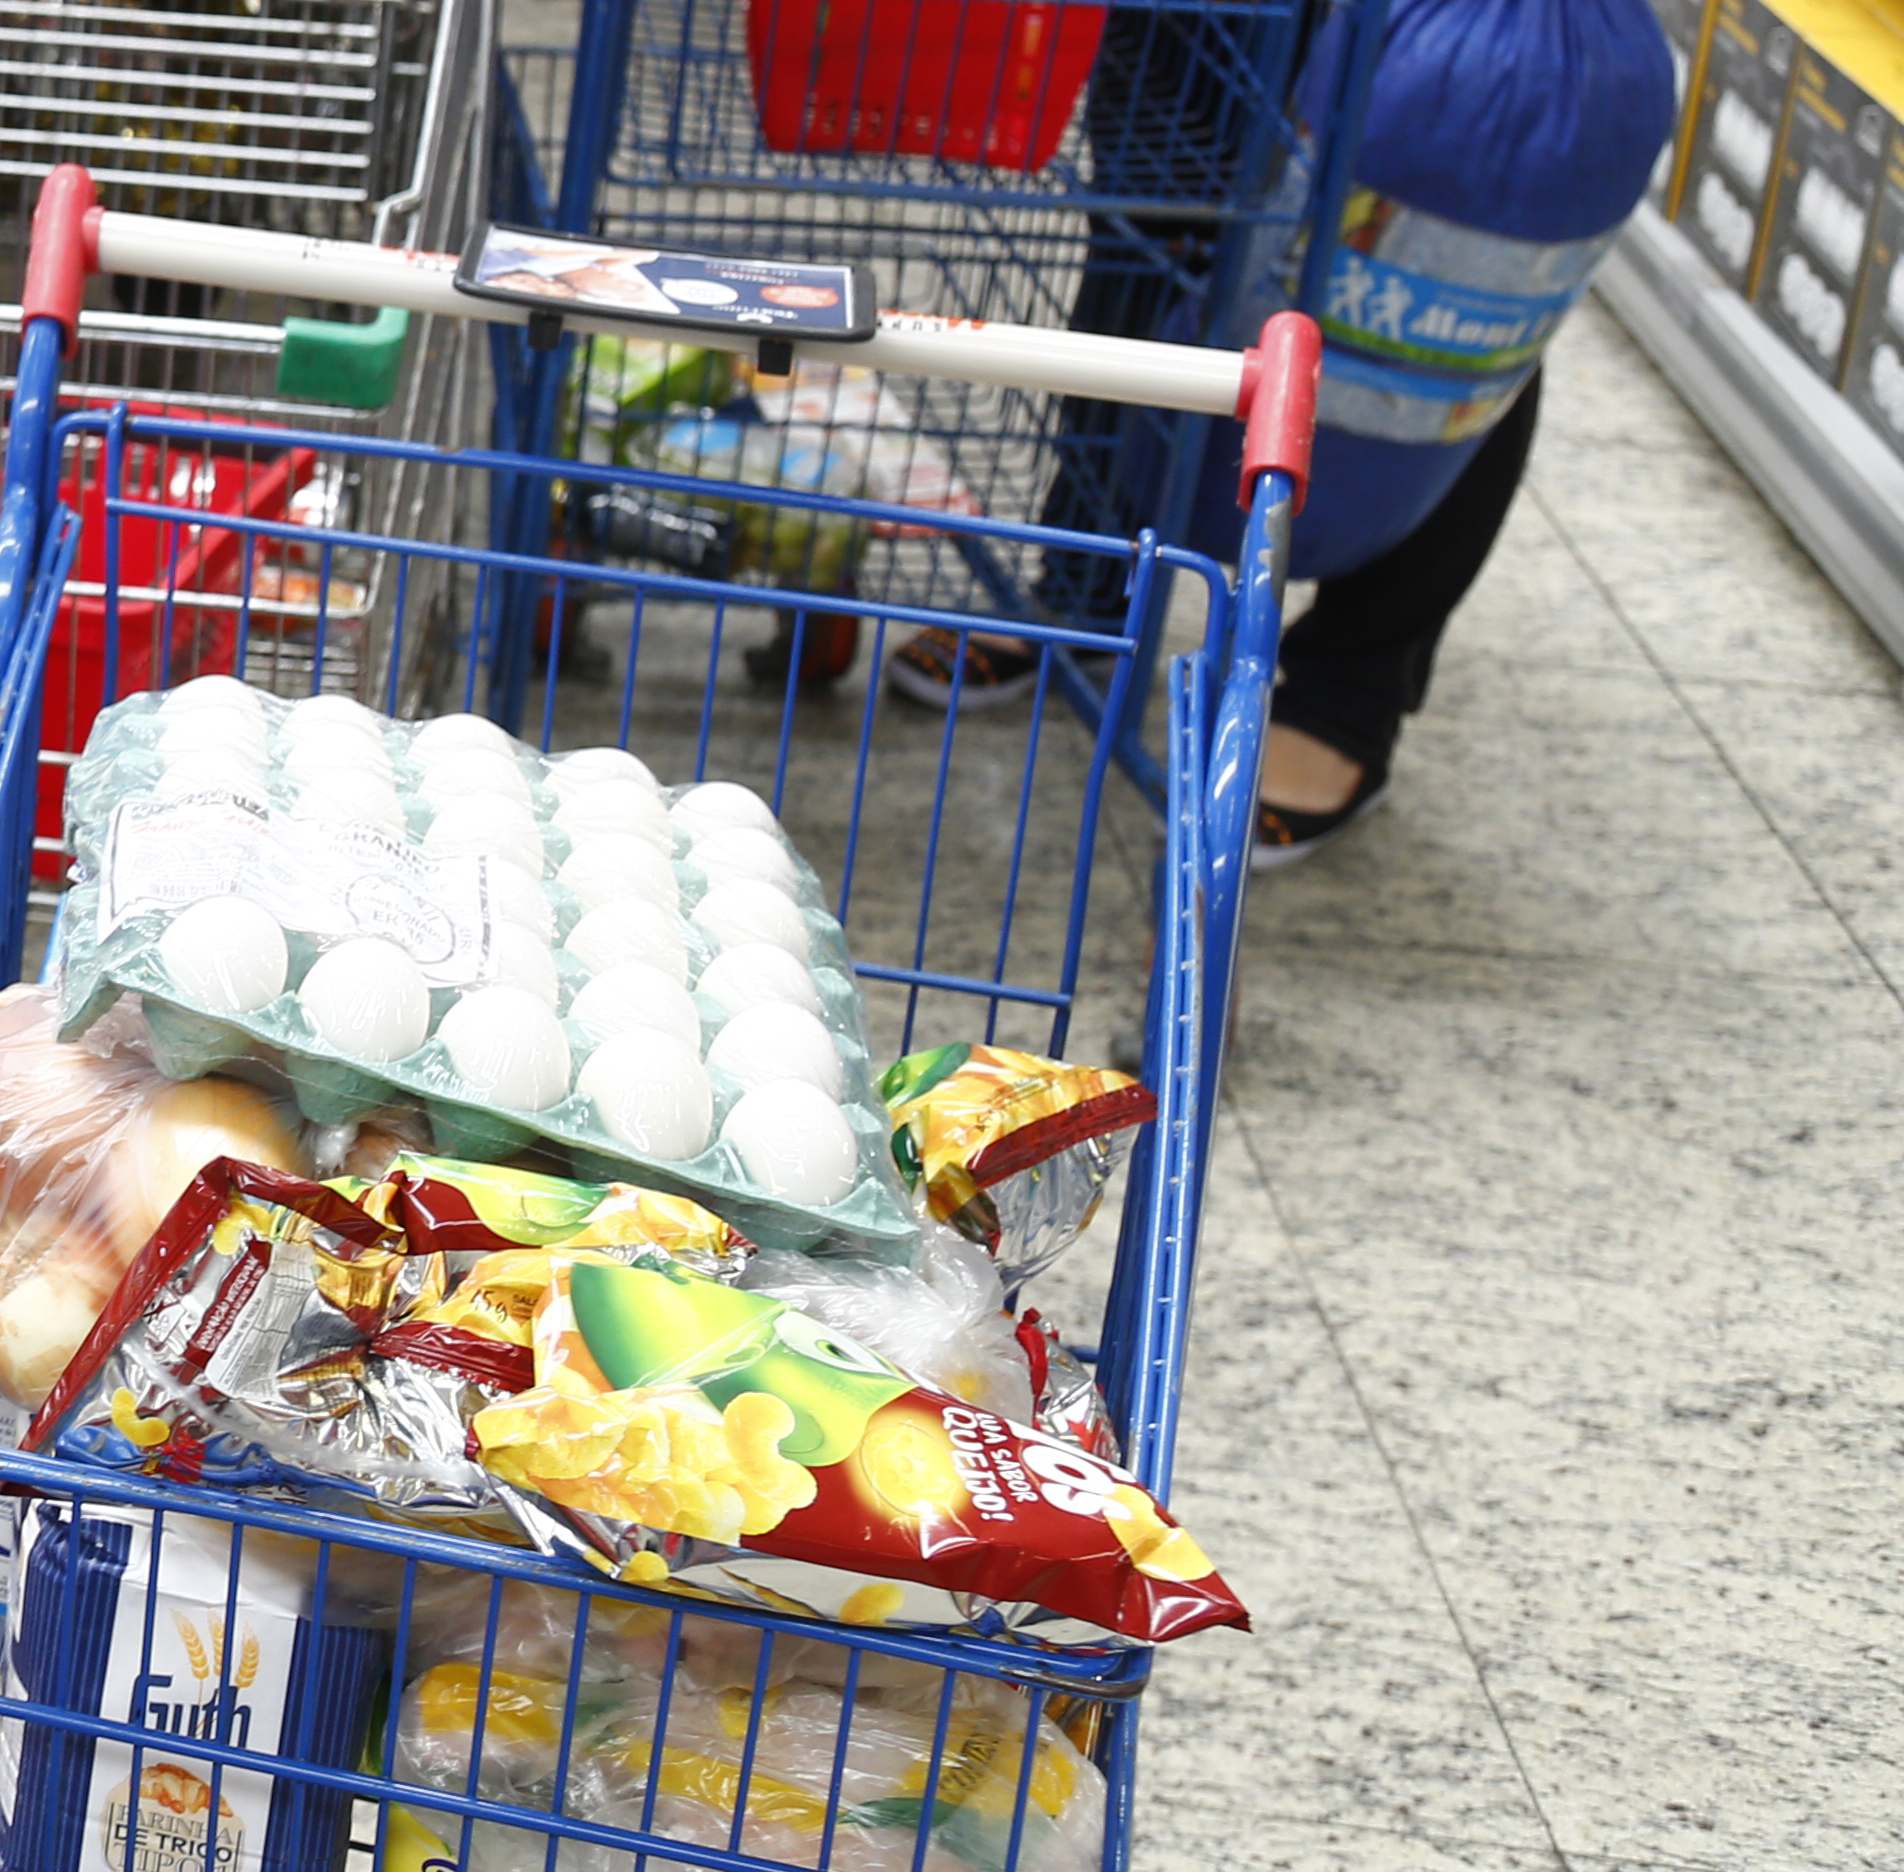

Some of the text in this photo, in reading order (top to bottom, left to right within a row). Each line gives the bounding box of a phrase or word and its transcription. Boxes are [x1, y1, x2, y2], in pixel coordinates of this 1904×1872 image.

[975, 1412, 1009, 1445] LUA
[942, 1406, 1015, 1522] QUEIJO!
[991, 1448, 1040, 1503] SABOR
[128, 1673, 252, 1749] Guth
